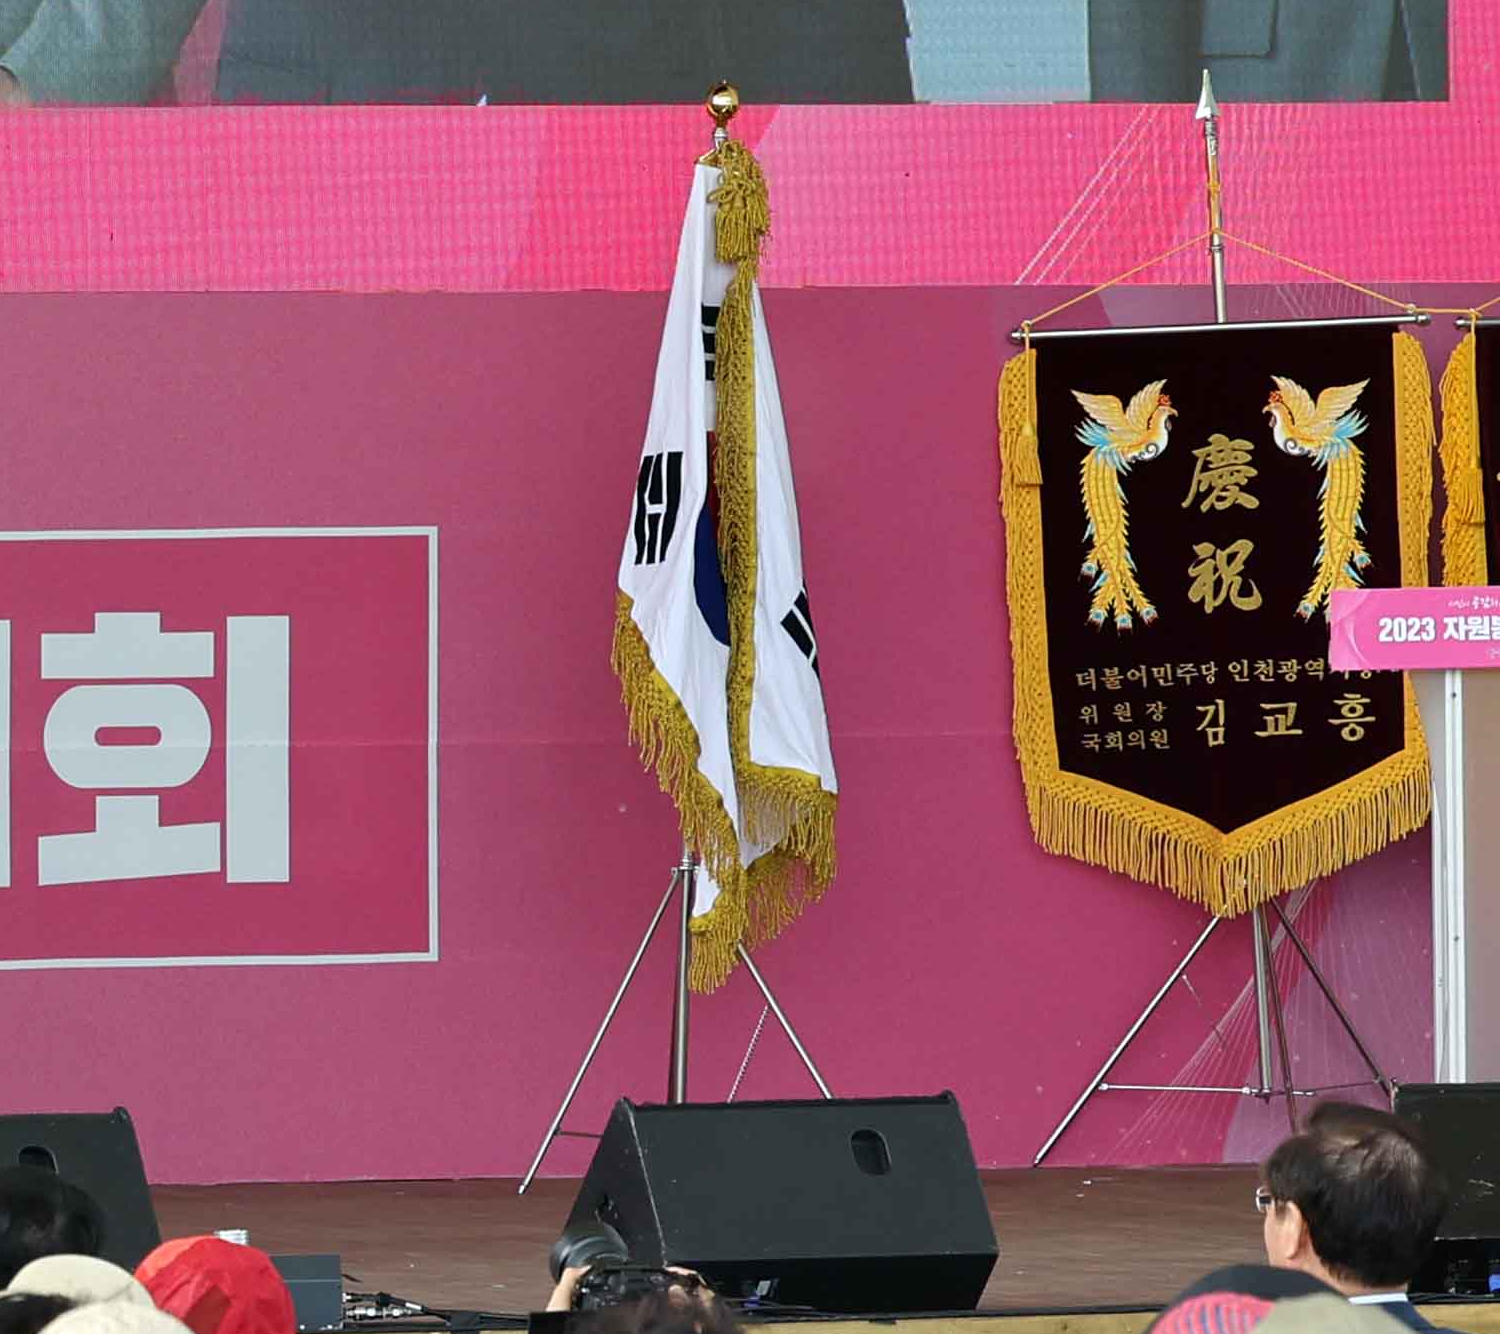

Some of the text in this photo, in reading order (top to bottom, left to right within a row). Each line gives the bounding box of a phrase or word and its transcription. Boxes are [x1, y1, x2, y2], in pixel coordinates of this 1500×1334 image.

[1181, 433, 1263, 614] 慶祝
[1378, 617, 1436, 642] 2023
[1076, 658, 1374, 691] 더불어민주당 인천광역
[1081, 729, 1170, 752] 국회의원
